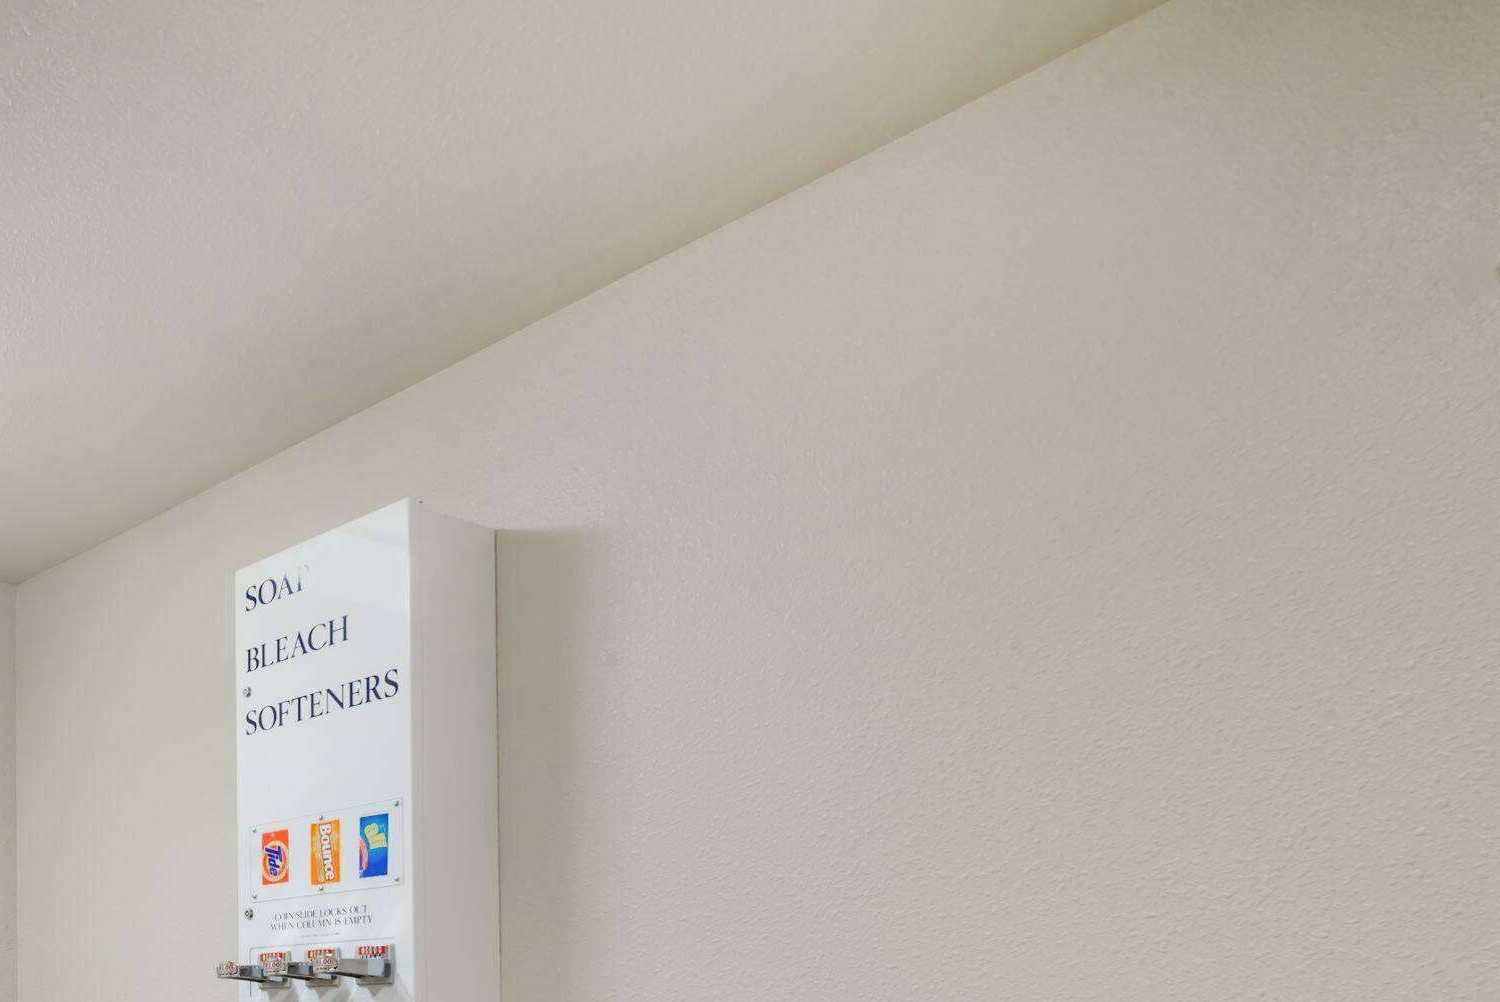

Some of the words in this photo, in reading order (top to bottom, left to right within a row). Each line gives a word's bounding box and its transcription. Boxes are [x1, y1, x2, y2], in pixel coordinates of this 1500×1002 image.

[245, 614, 349, 673] BLEACH
[244, 668, 400, 736] SOFTENERS
[265, 845, 282, 877] Tide
[319, 823, 335, 880] Bounce
